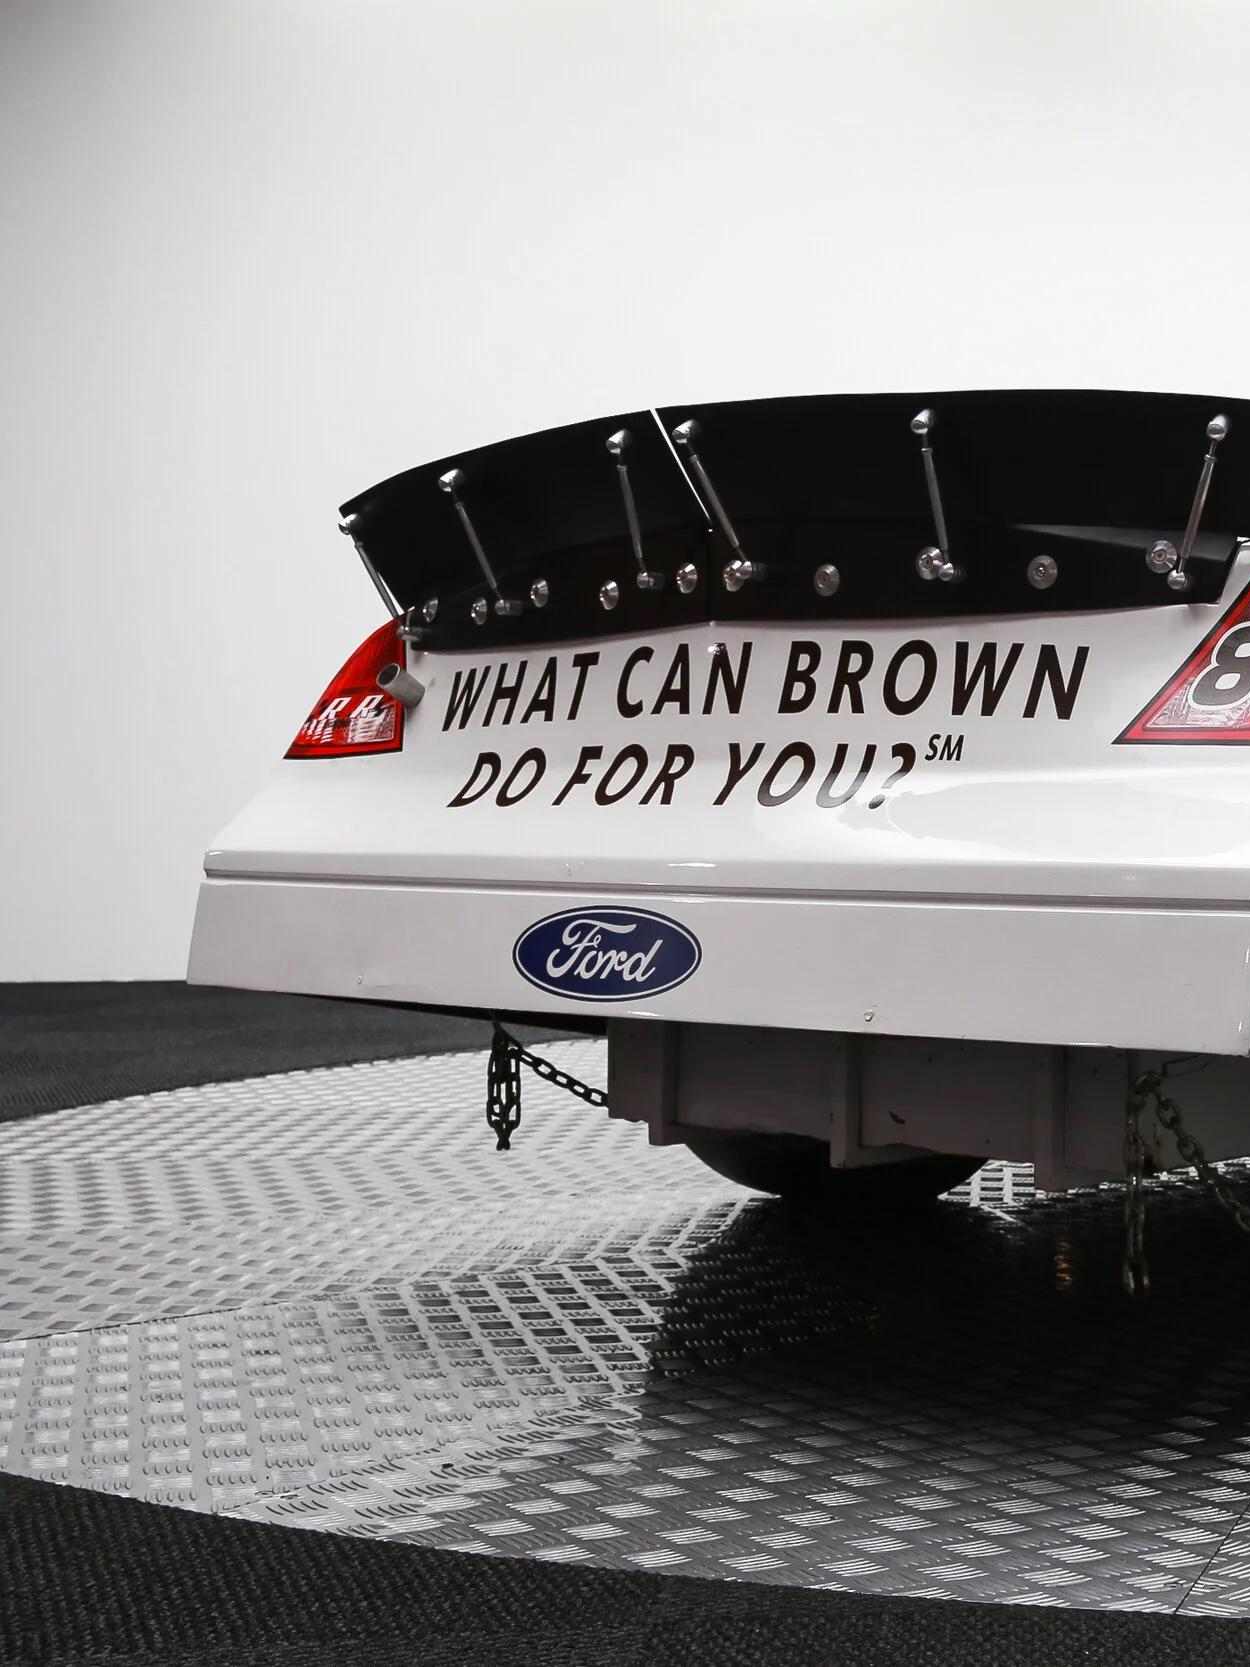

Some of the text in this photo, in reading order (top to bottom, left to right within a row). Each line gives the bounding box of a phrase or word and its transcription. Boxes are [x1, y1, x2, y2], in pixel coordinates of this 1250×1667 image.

[442, 639, 1090, 732] WHAT CAN BROWN
[446, 733, 965, 809] DO FOR YOU? SM
[546, 918, 663, 982] Ford
